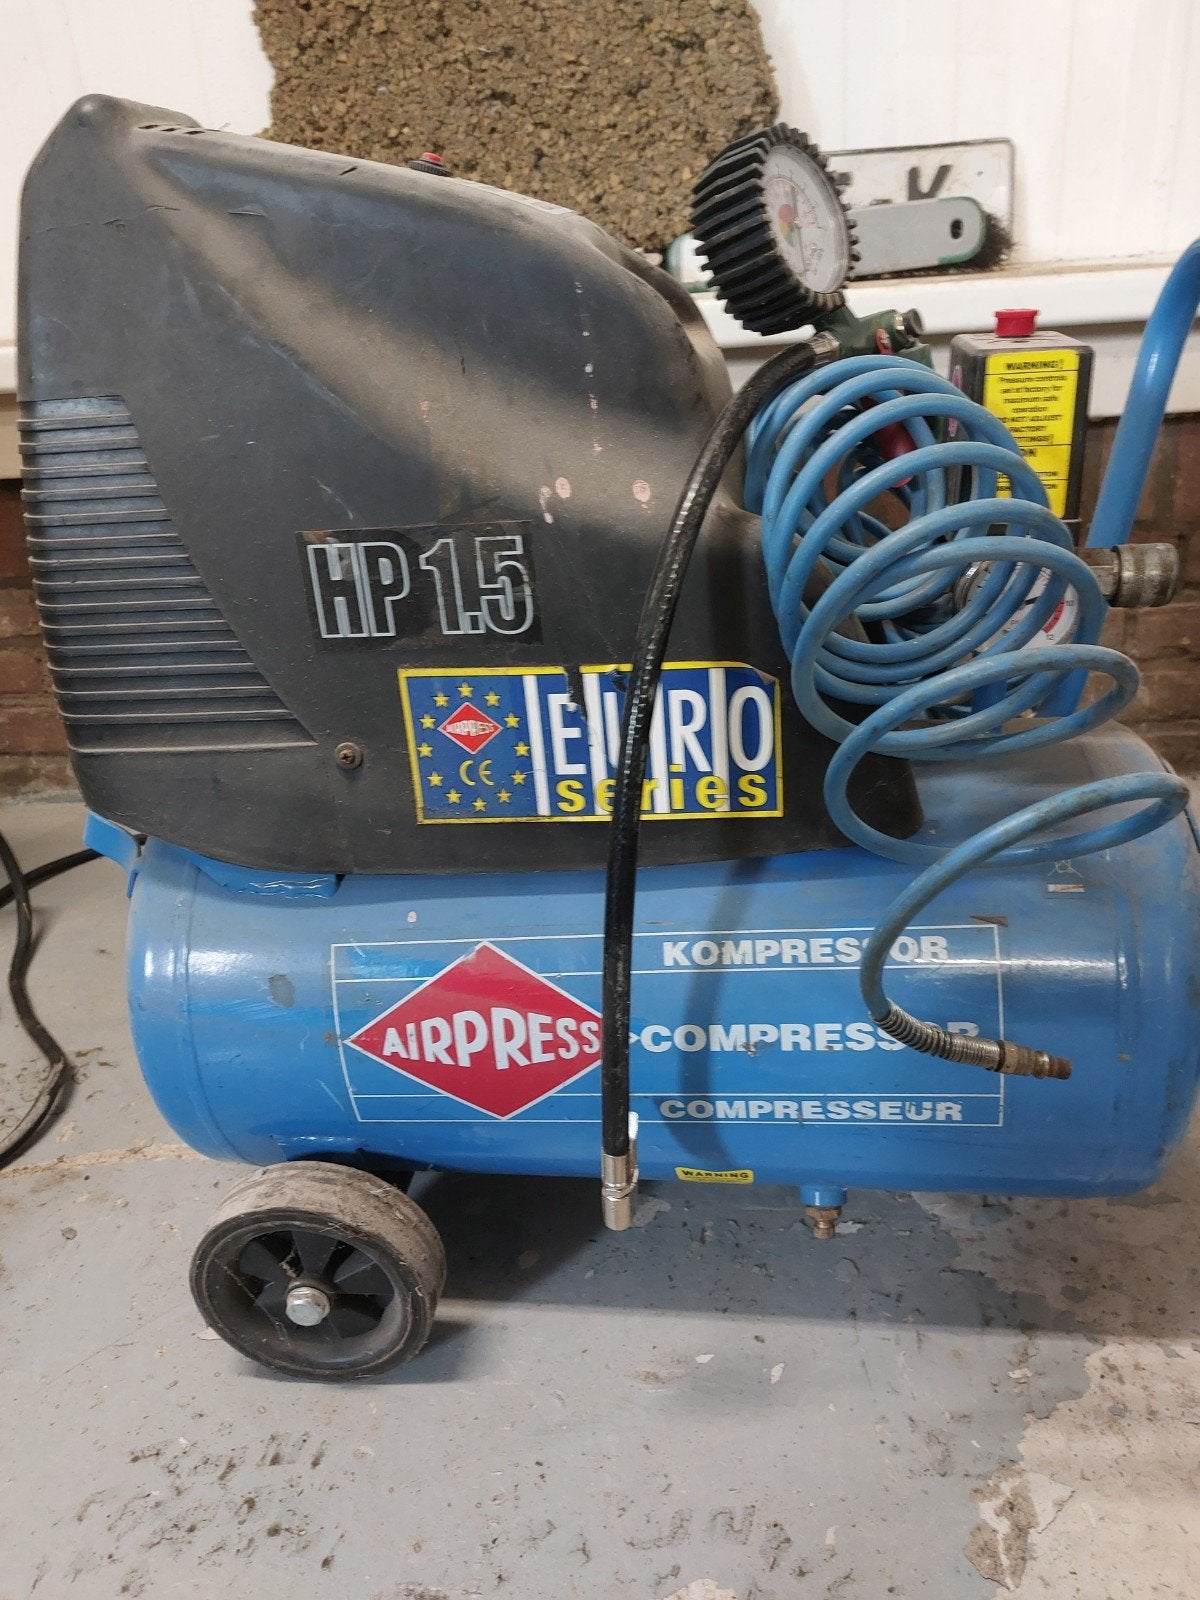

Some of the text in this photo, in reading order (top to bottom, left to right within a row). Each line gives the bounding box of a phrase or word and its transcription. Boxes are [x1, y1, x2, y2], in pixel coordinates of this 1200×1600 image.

[306, 535, 534, 638] HP 1.5
[662, 935, 949, 967] KOMPRESOR
[382, 1007, 602, 1070] AIRPRESS
[660, 1100, 963, 1121] COMPRESSEUR
[681, 1169, 749, 1178] WARNING
